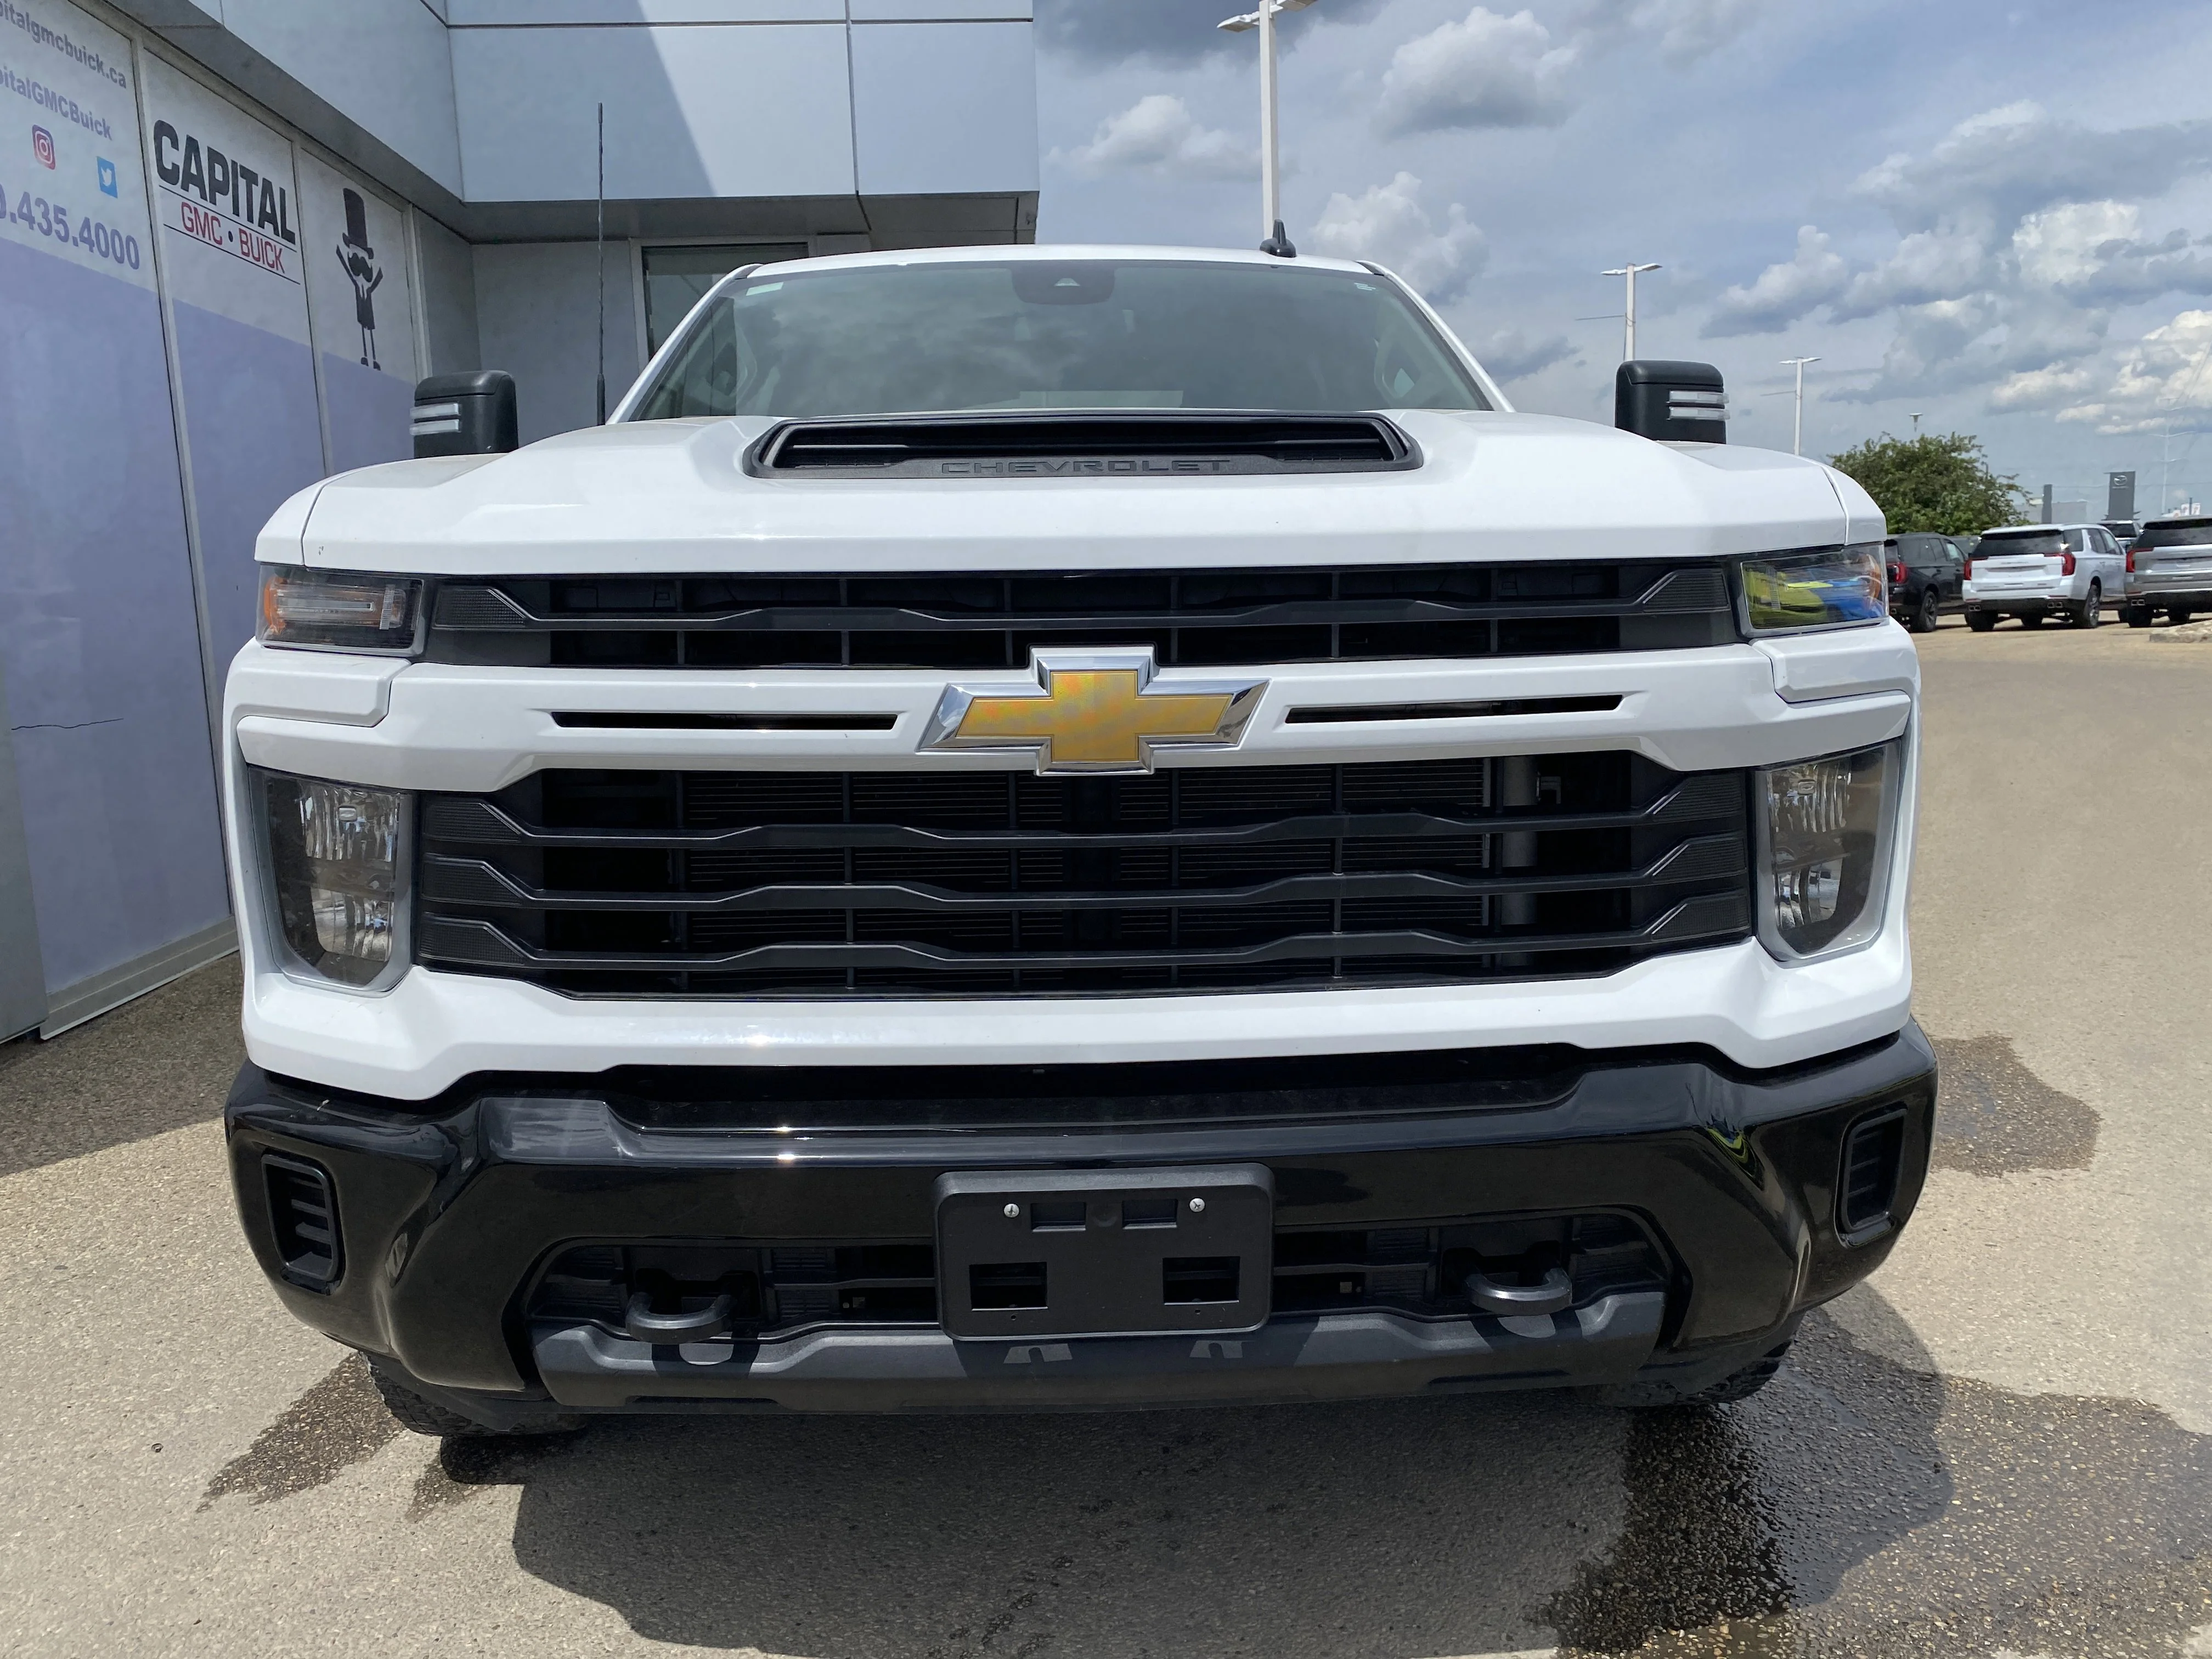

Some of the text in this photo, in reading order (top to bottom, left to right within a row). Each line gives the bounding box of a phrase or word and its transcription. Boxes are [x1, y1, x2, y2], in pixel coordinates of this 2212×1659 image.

[153, 120, 296, 245] CAPITAL
[181, 201, 285, 274] GMC BUICK
[941, 459, 1231, 474] CHEVROLET
